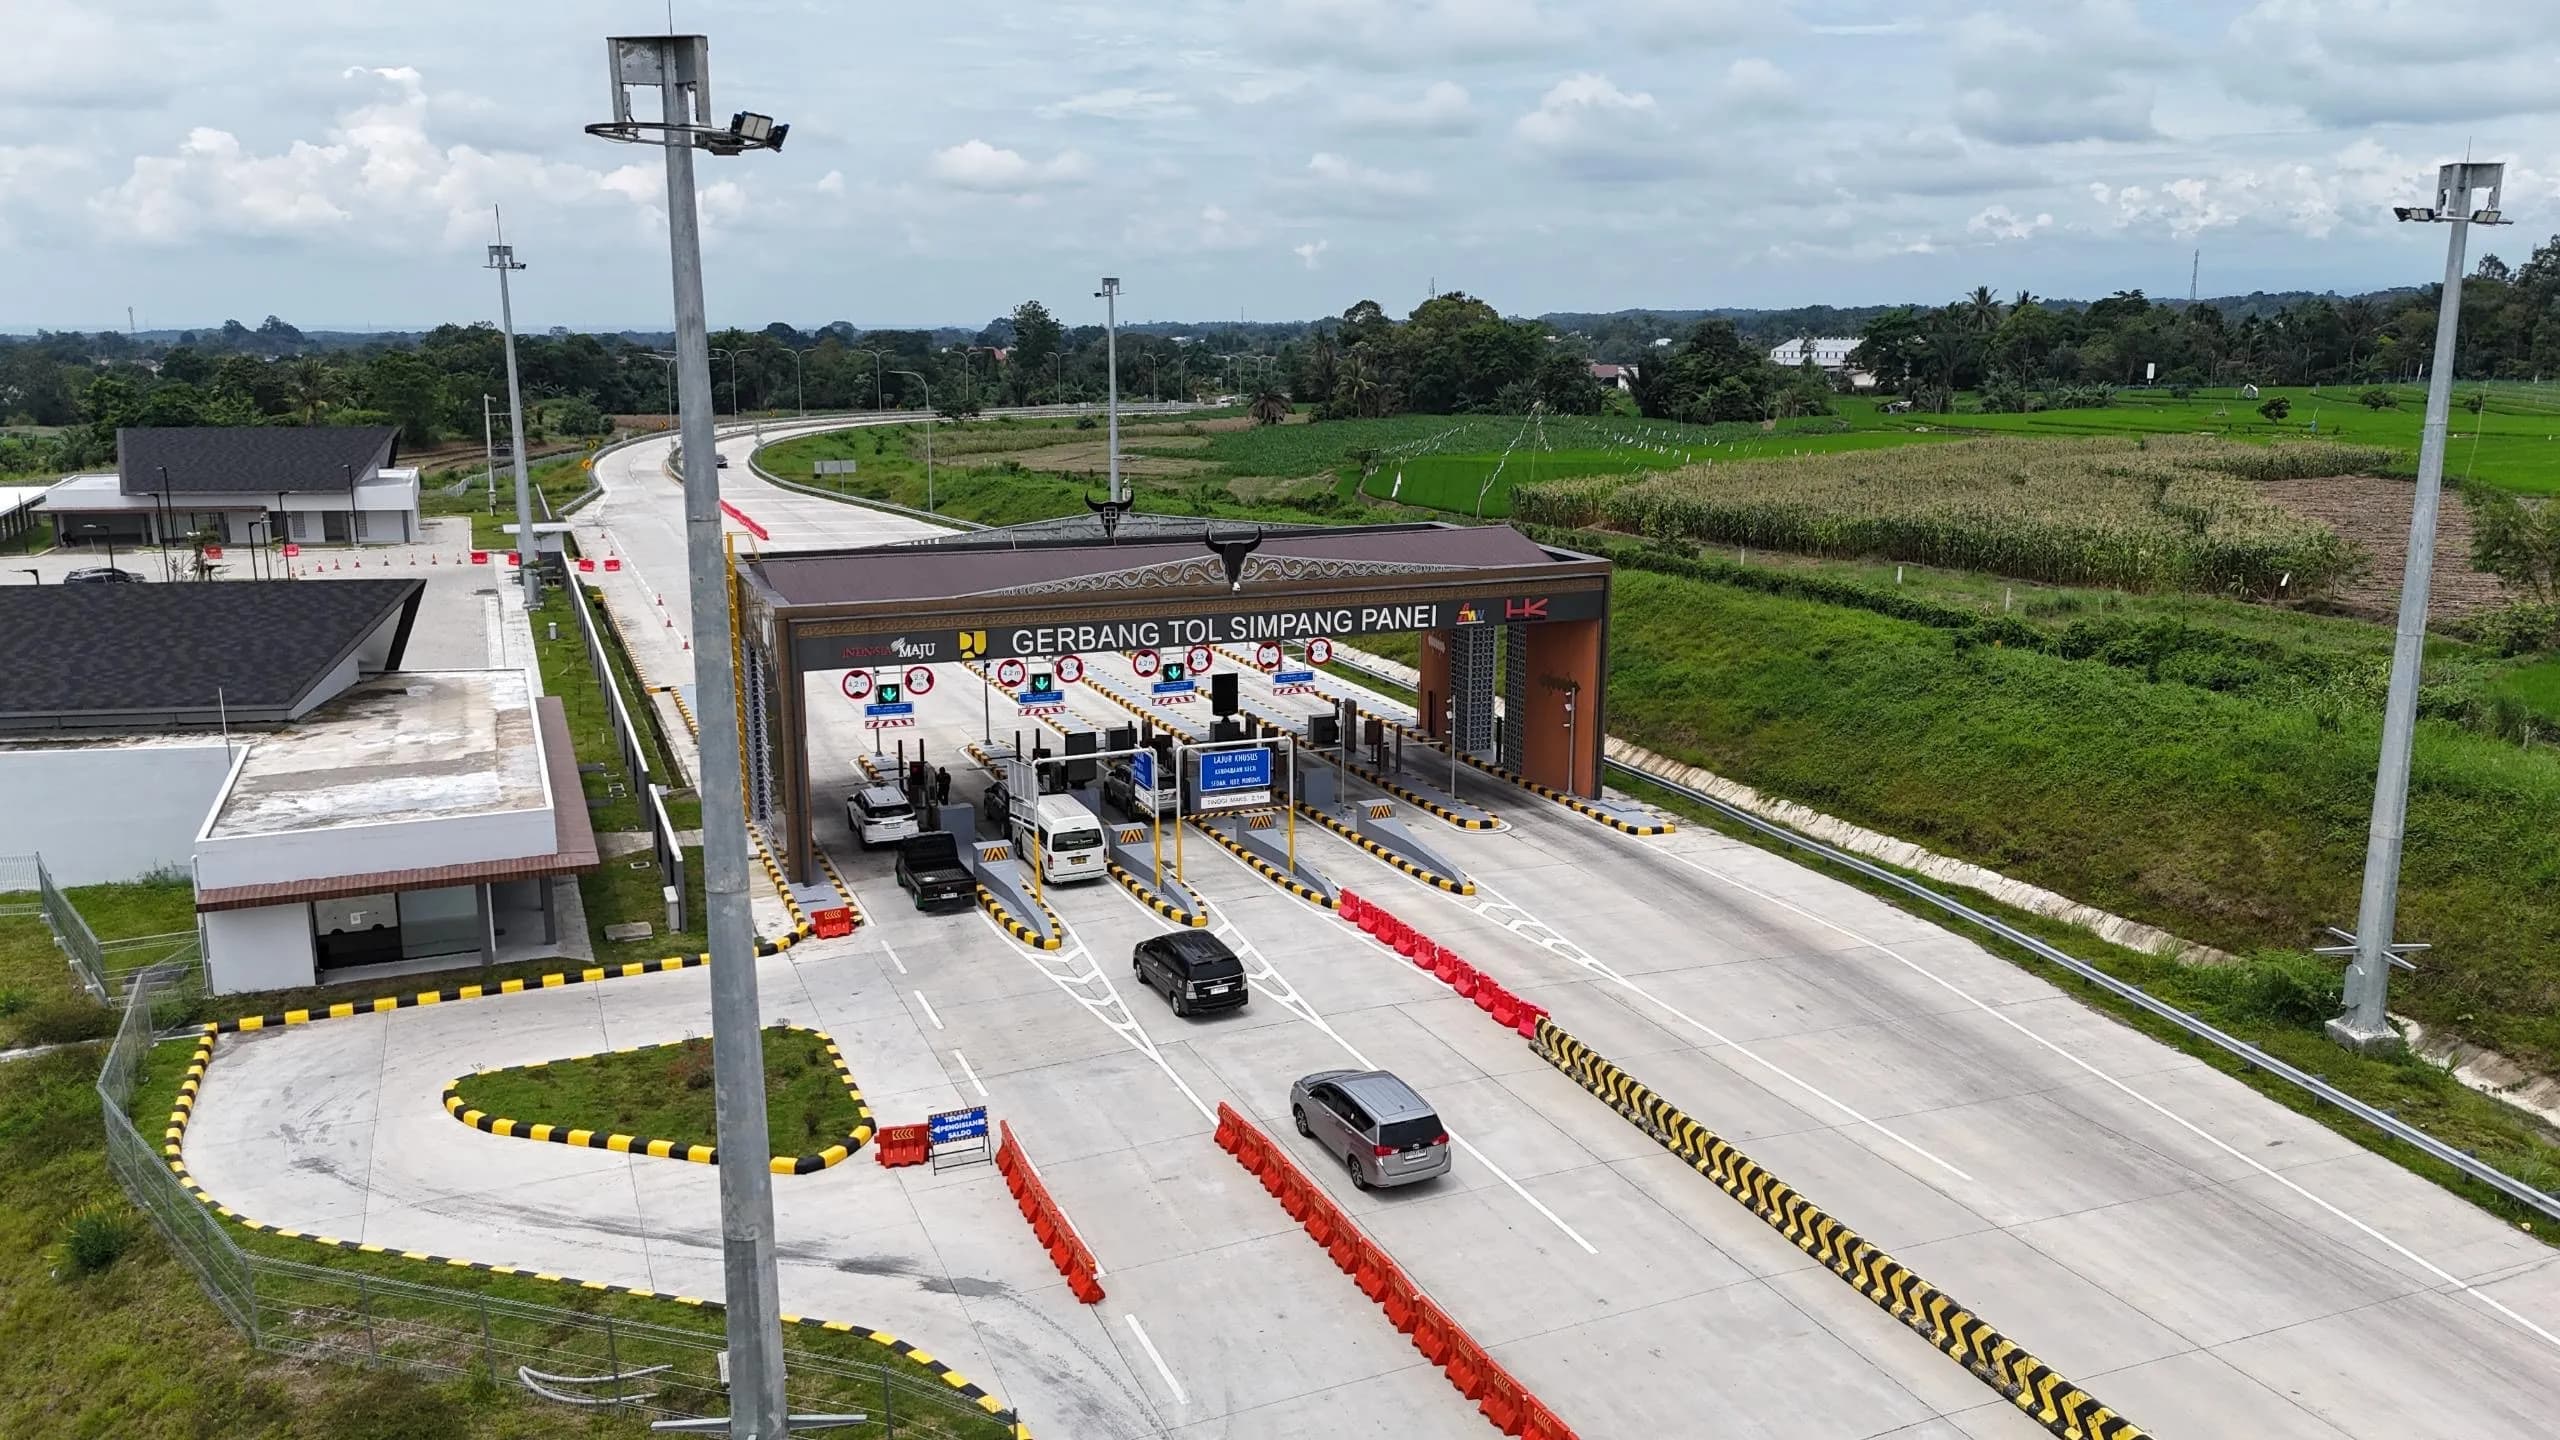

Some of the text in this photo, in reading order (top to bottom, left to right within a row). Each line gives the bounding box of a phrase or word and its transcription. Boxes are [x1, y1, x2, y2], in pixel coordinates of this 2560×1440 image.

[1505, 598, 1549, 619] HK
[1012, 604, 1437, 655] GERBANG TOL SIMPANG PANEI
[898, 643, 936, 659] MAJU
[1213, 752, 1258, 764] LAJUR KHUSUS
[944, 1112, 973, 1124] TEMPAT
[940, 1119, 978, 1132] PENGISIAN
[948, 1129, 972, 1139] SALDO
